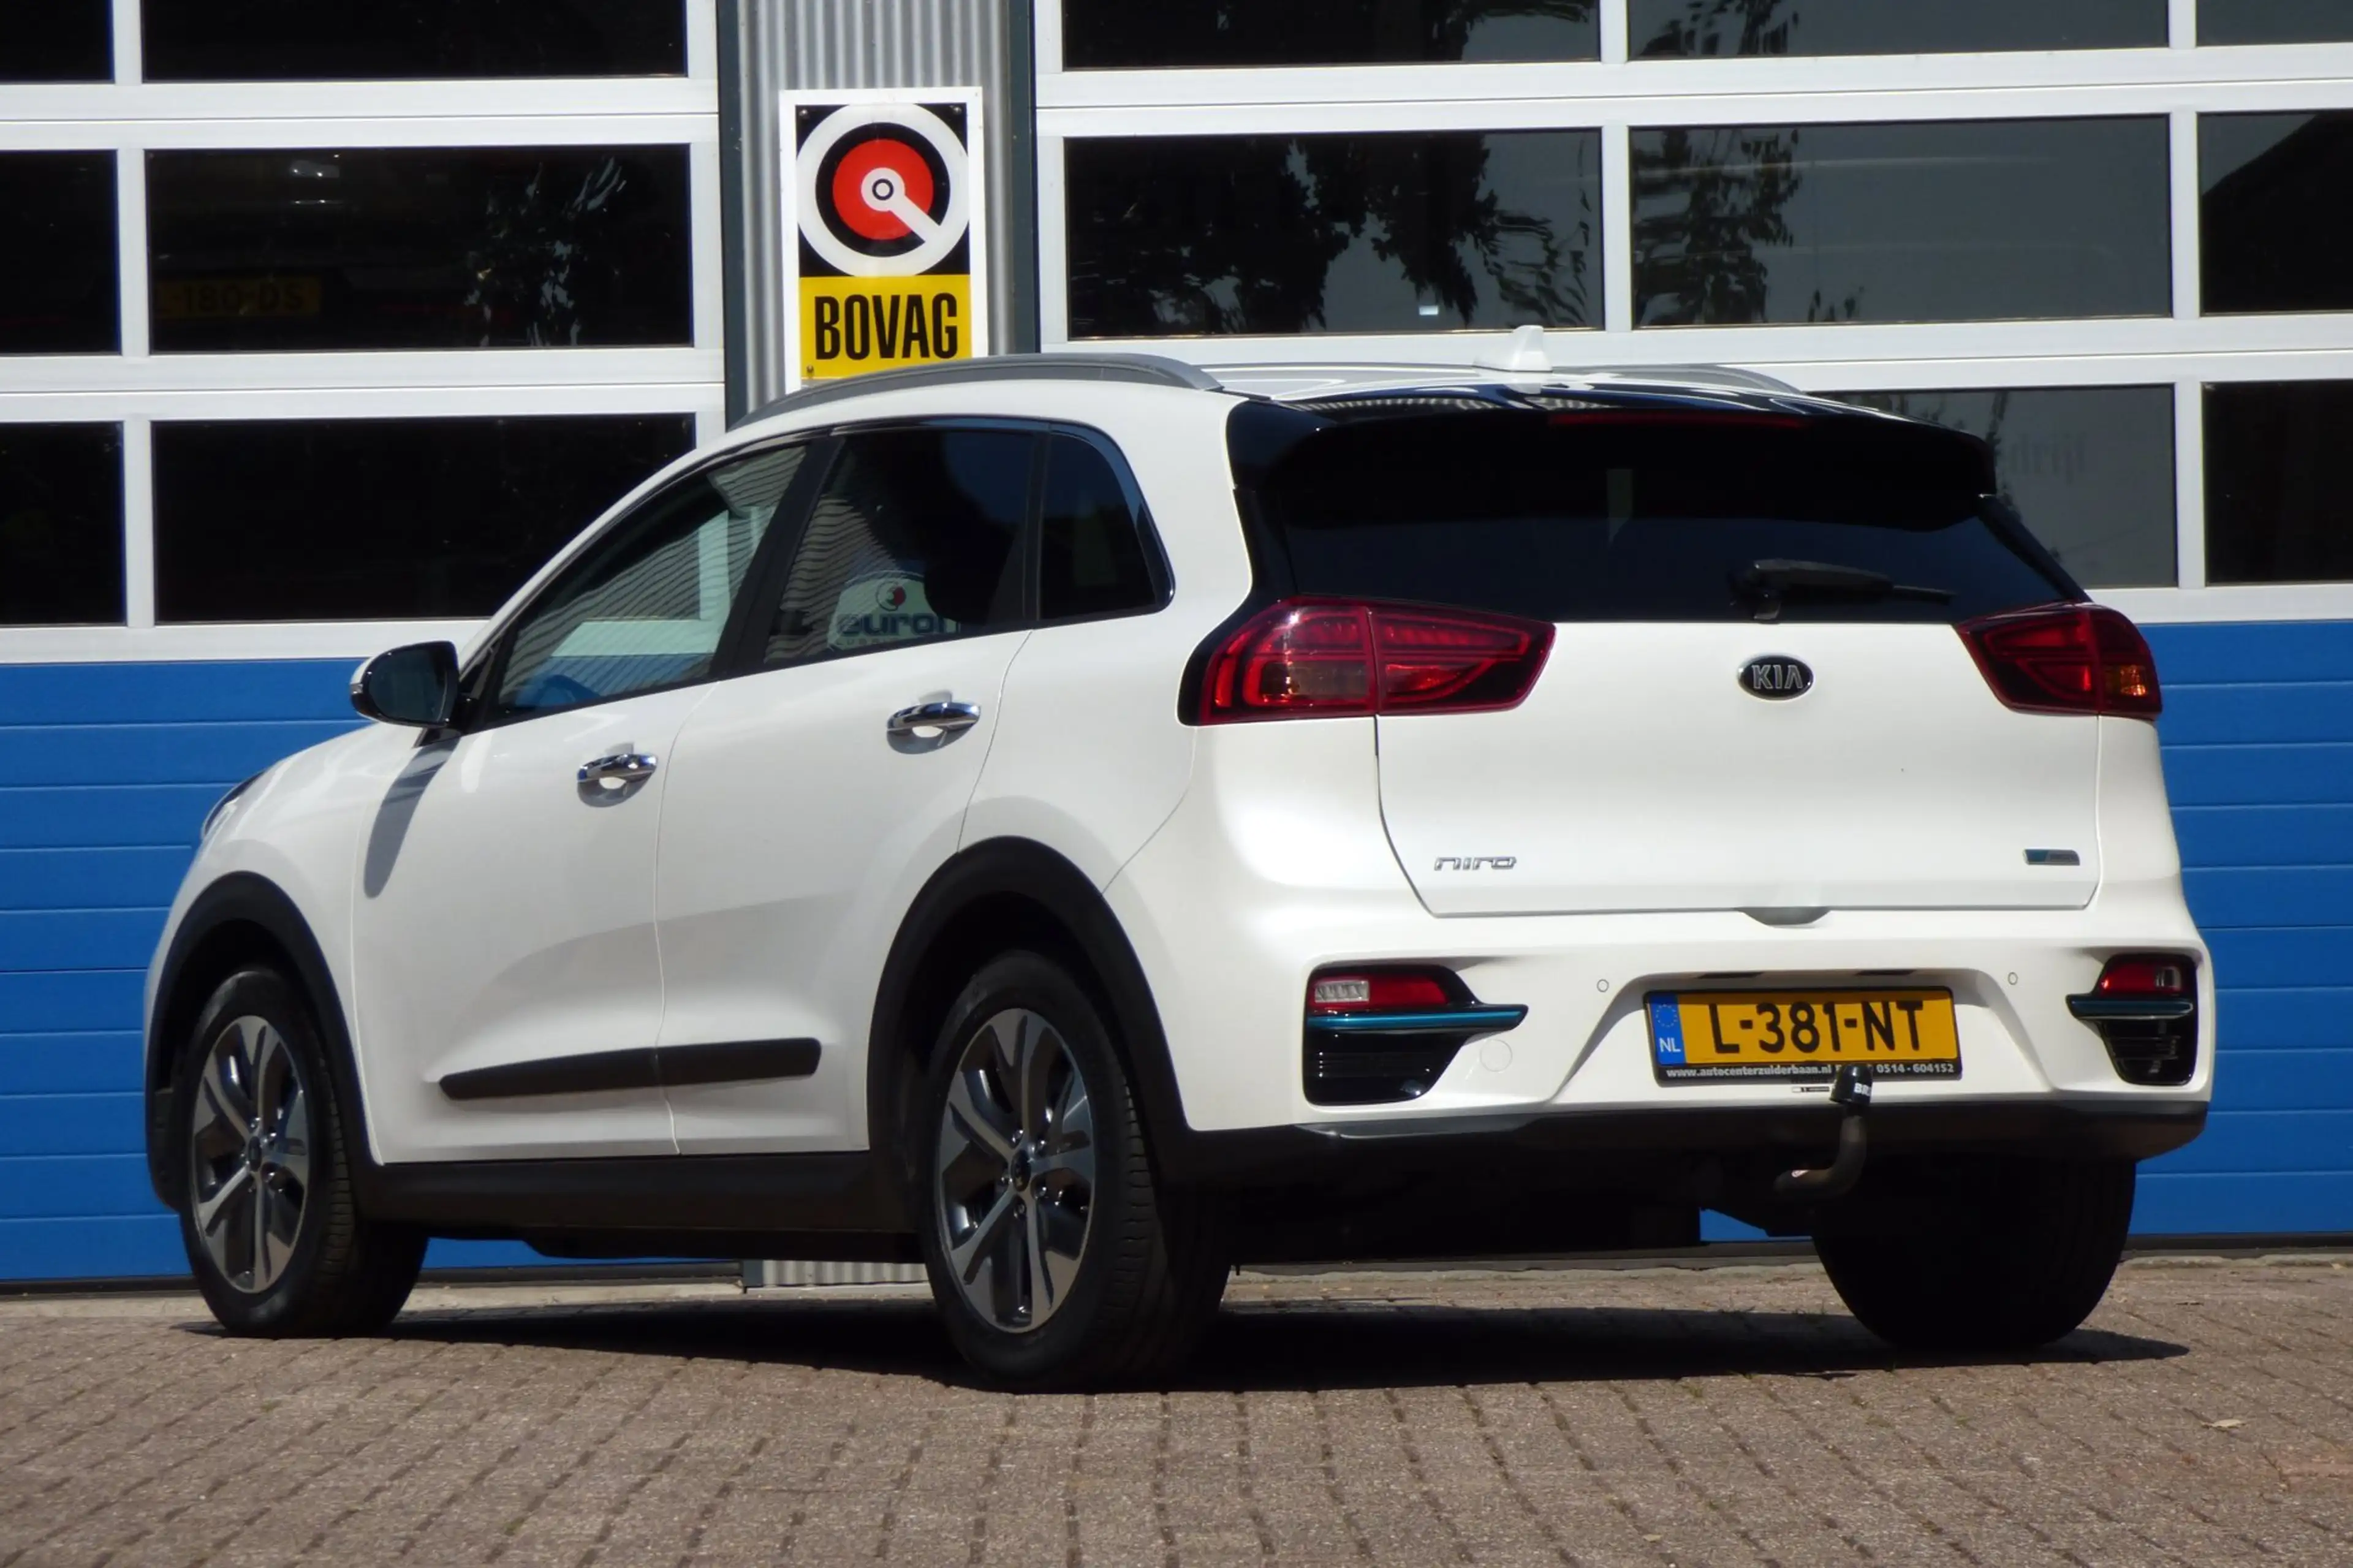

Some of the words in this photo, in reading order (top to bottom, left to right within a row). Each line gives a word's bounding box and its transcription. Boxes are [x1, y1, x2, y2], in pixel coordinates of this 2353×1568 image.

[814, 292, 958, 360] BOVAG
[1751, 664, 1803, 689] KIA
[1709, 1001, 1923, 1053] L-381-NT
[1659, 1037, 1681, 1053] NL
[1666, 1064, 1832, 1078] www.autocenterzuiderbaan.nl
